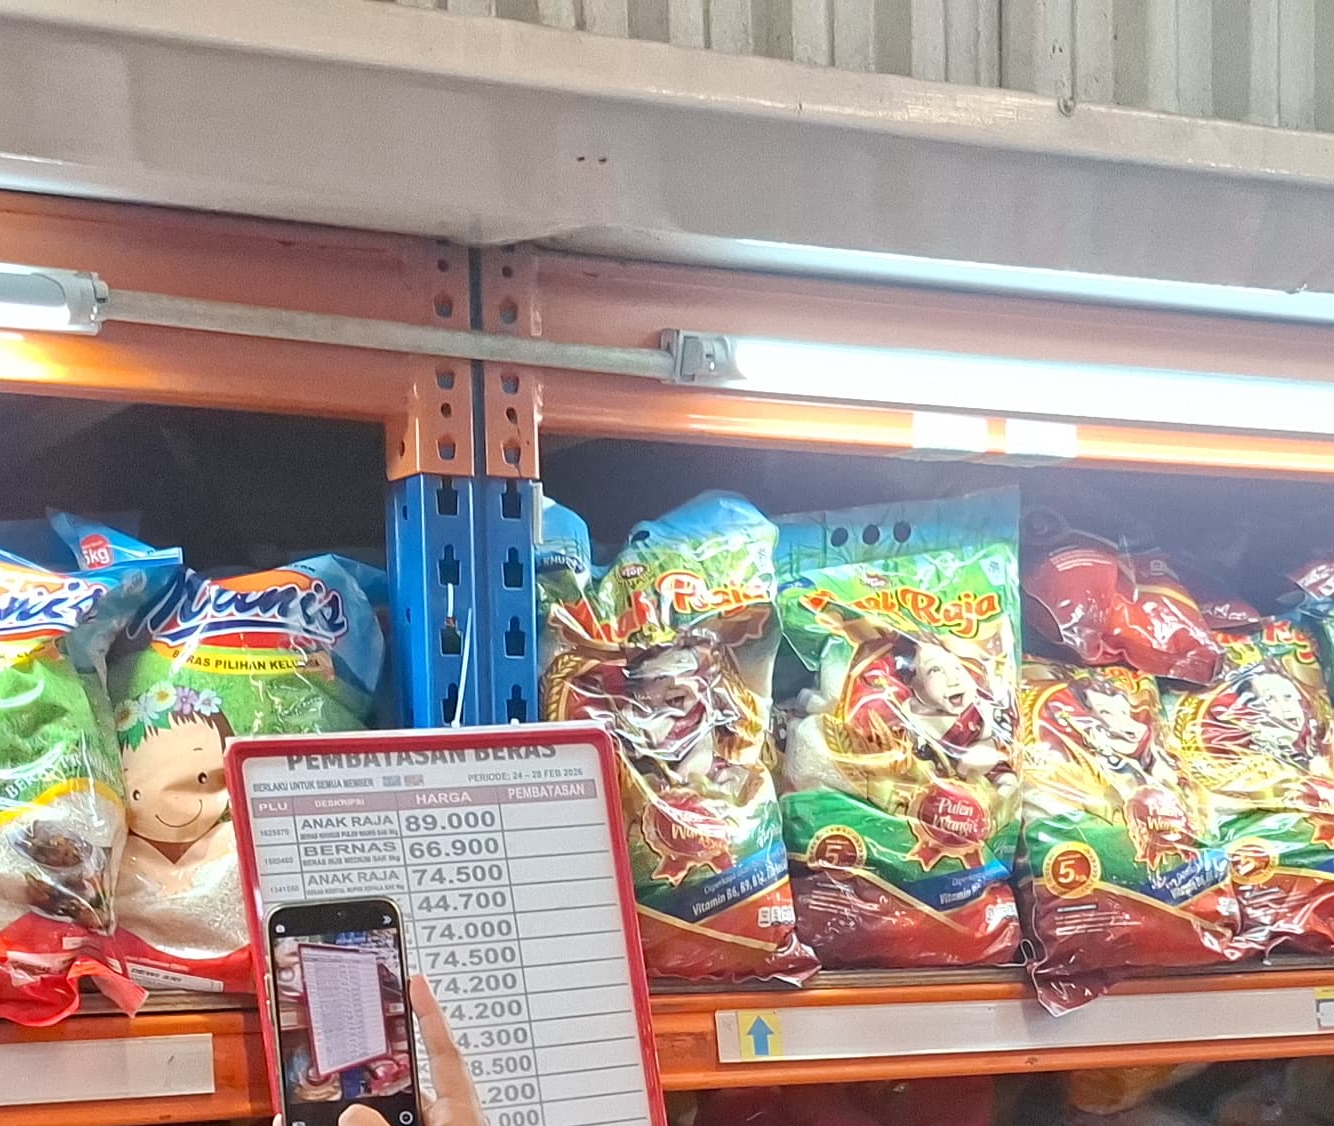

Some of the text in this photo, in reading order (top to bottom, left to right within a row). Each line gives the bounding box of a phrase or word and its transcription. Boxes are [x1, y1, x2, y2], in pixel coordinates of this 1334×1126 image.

[898, 587, 1001, 639] Raja
[172, 649, 211, 668] BRAS
[214, 658, 267, 671] PILIHAN
[287, 749, 466, 771] PEMBATASAN
[467, 772, 511, 783] PERIODE:
[544, 769, 561, 778] FEB
[415, 791, 472, 805] HARGA
[508, 783, 585, 800] PEMBATASAN
[258, 802, 288, 812] PLU
[938, 797, 974, 817] Pulen
[301, 814, 394, 831] ANAK RAJA
[405, 810, 496, 833] 89.000
[303, 840, 397, 857] BERNAS
[409, 837, 500, 859] 66.900
[307, 869, 400, 887] ANAK RAJA
[412, 863, 504, 887] 74.500
[417, 890, 508, 913] 44.700
[692, 891, 726, 917] Vitamin
[422, 918, 513, 943] 74.000
[425, 945, 517, 970] 74.500
[432, 972, 518, 995] 74.200
[465, 1054, 533, 1077] 8.500
